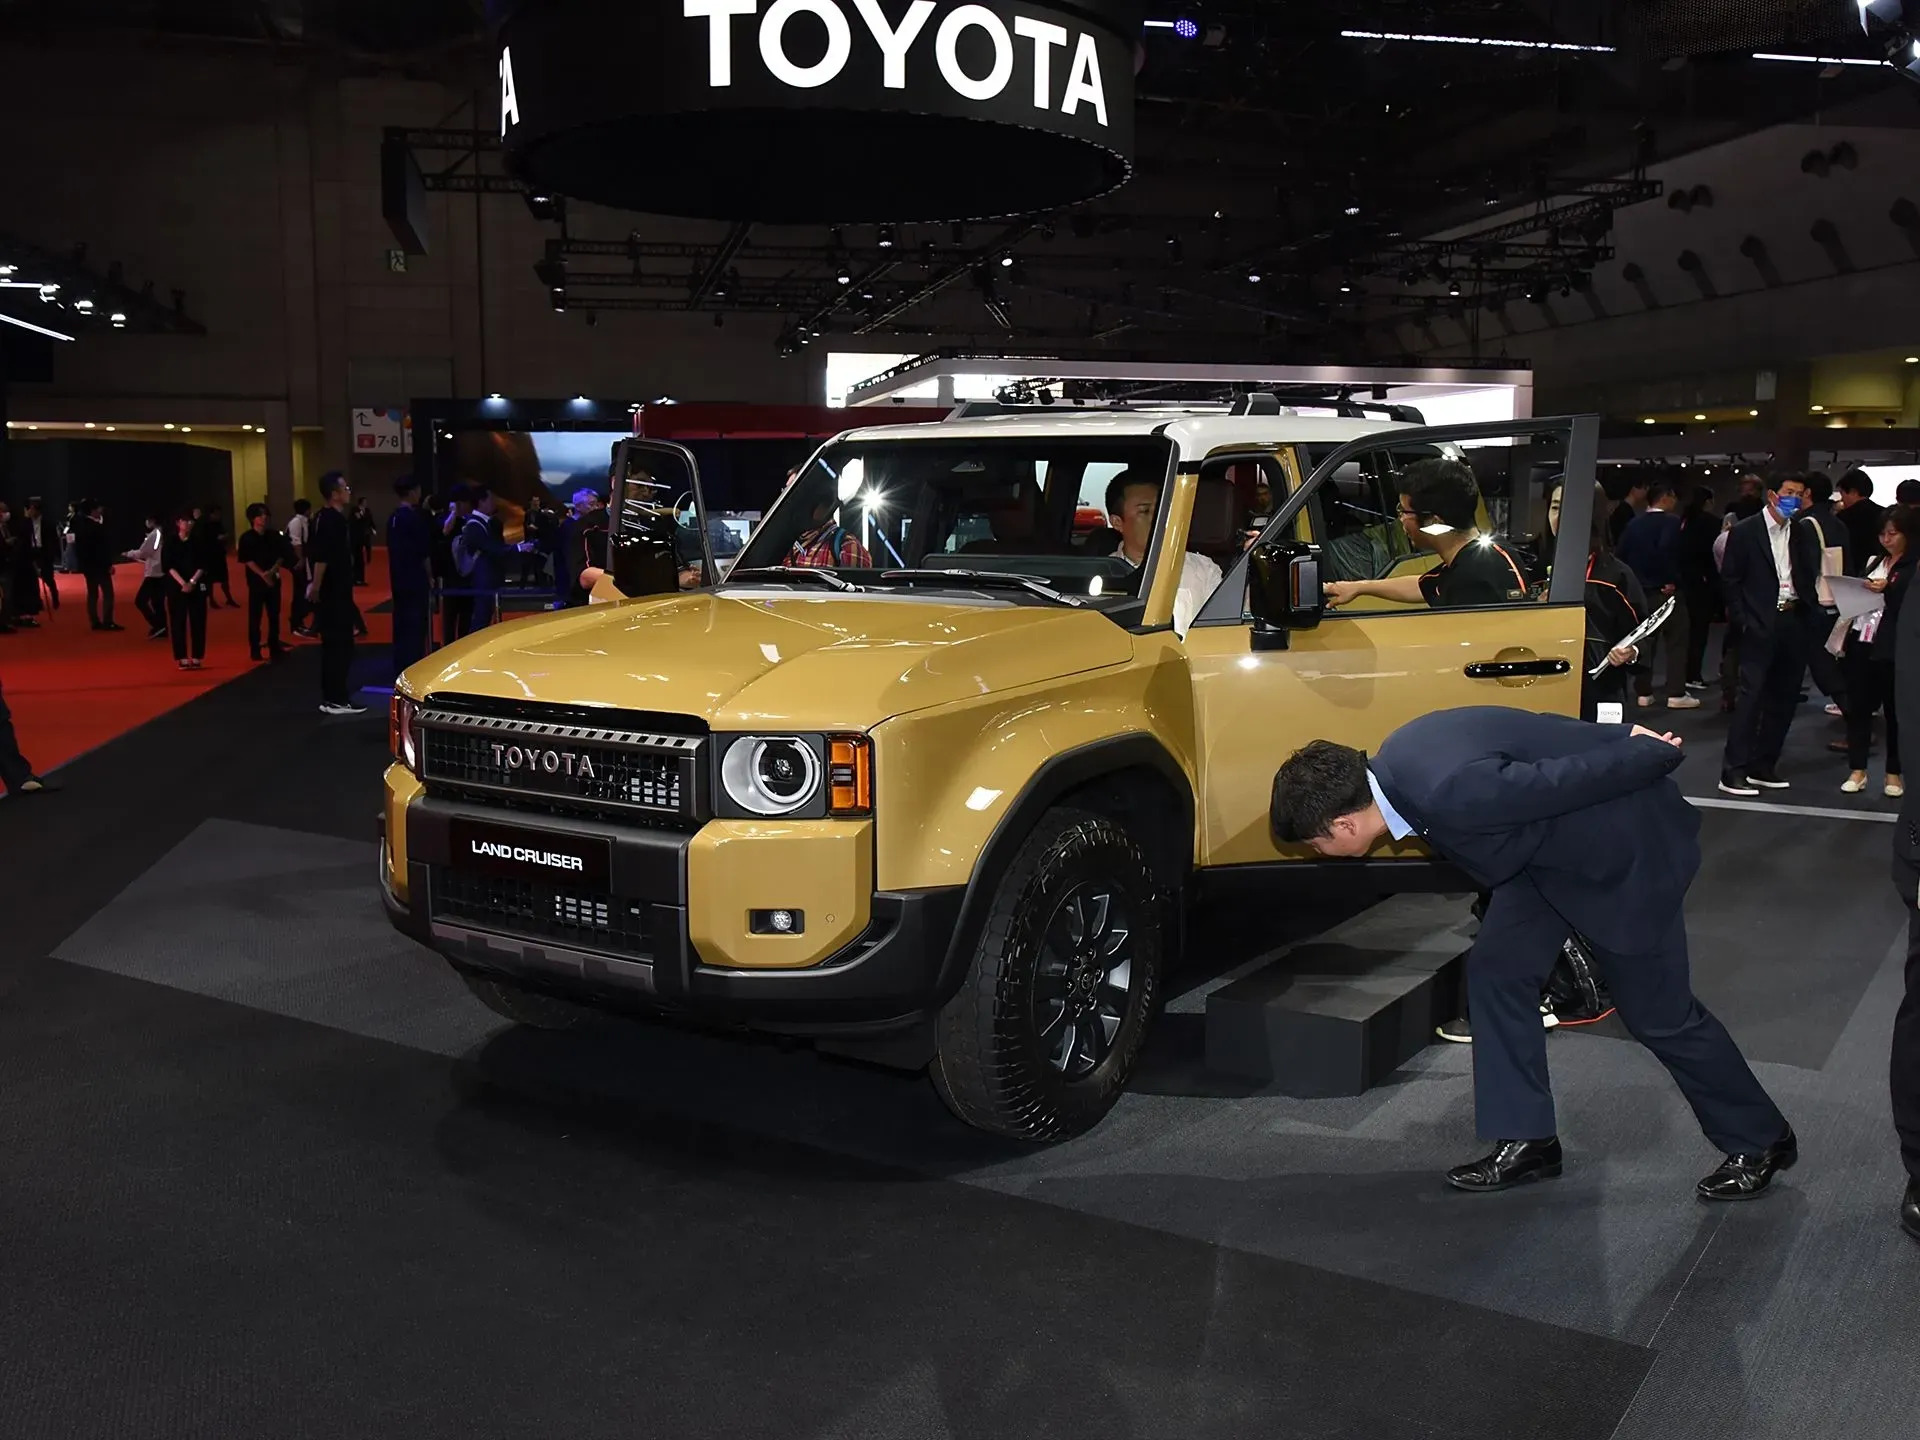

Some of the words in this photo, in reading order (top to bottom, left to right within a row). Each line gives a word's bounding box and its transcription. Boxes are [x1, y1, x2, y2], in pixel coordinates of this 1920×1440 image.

[684, 0, 1108, 127] TOYOTA
[491, 744, 595, 778] TOYOTA
[471, 840, 512, 859] LAND
[513, 847, 583, 871] CRUISER
